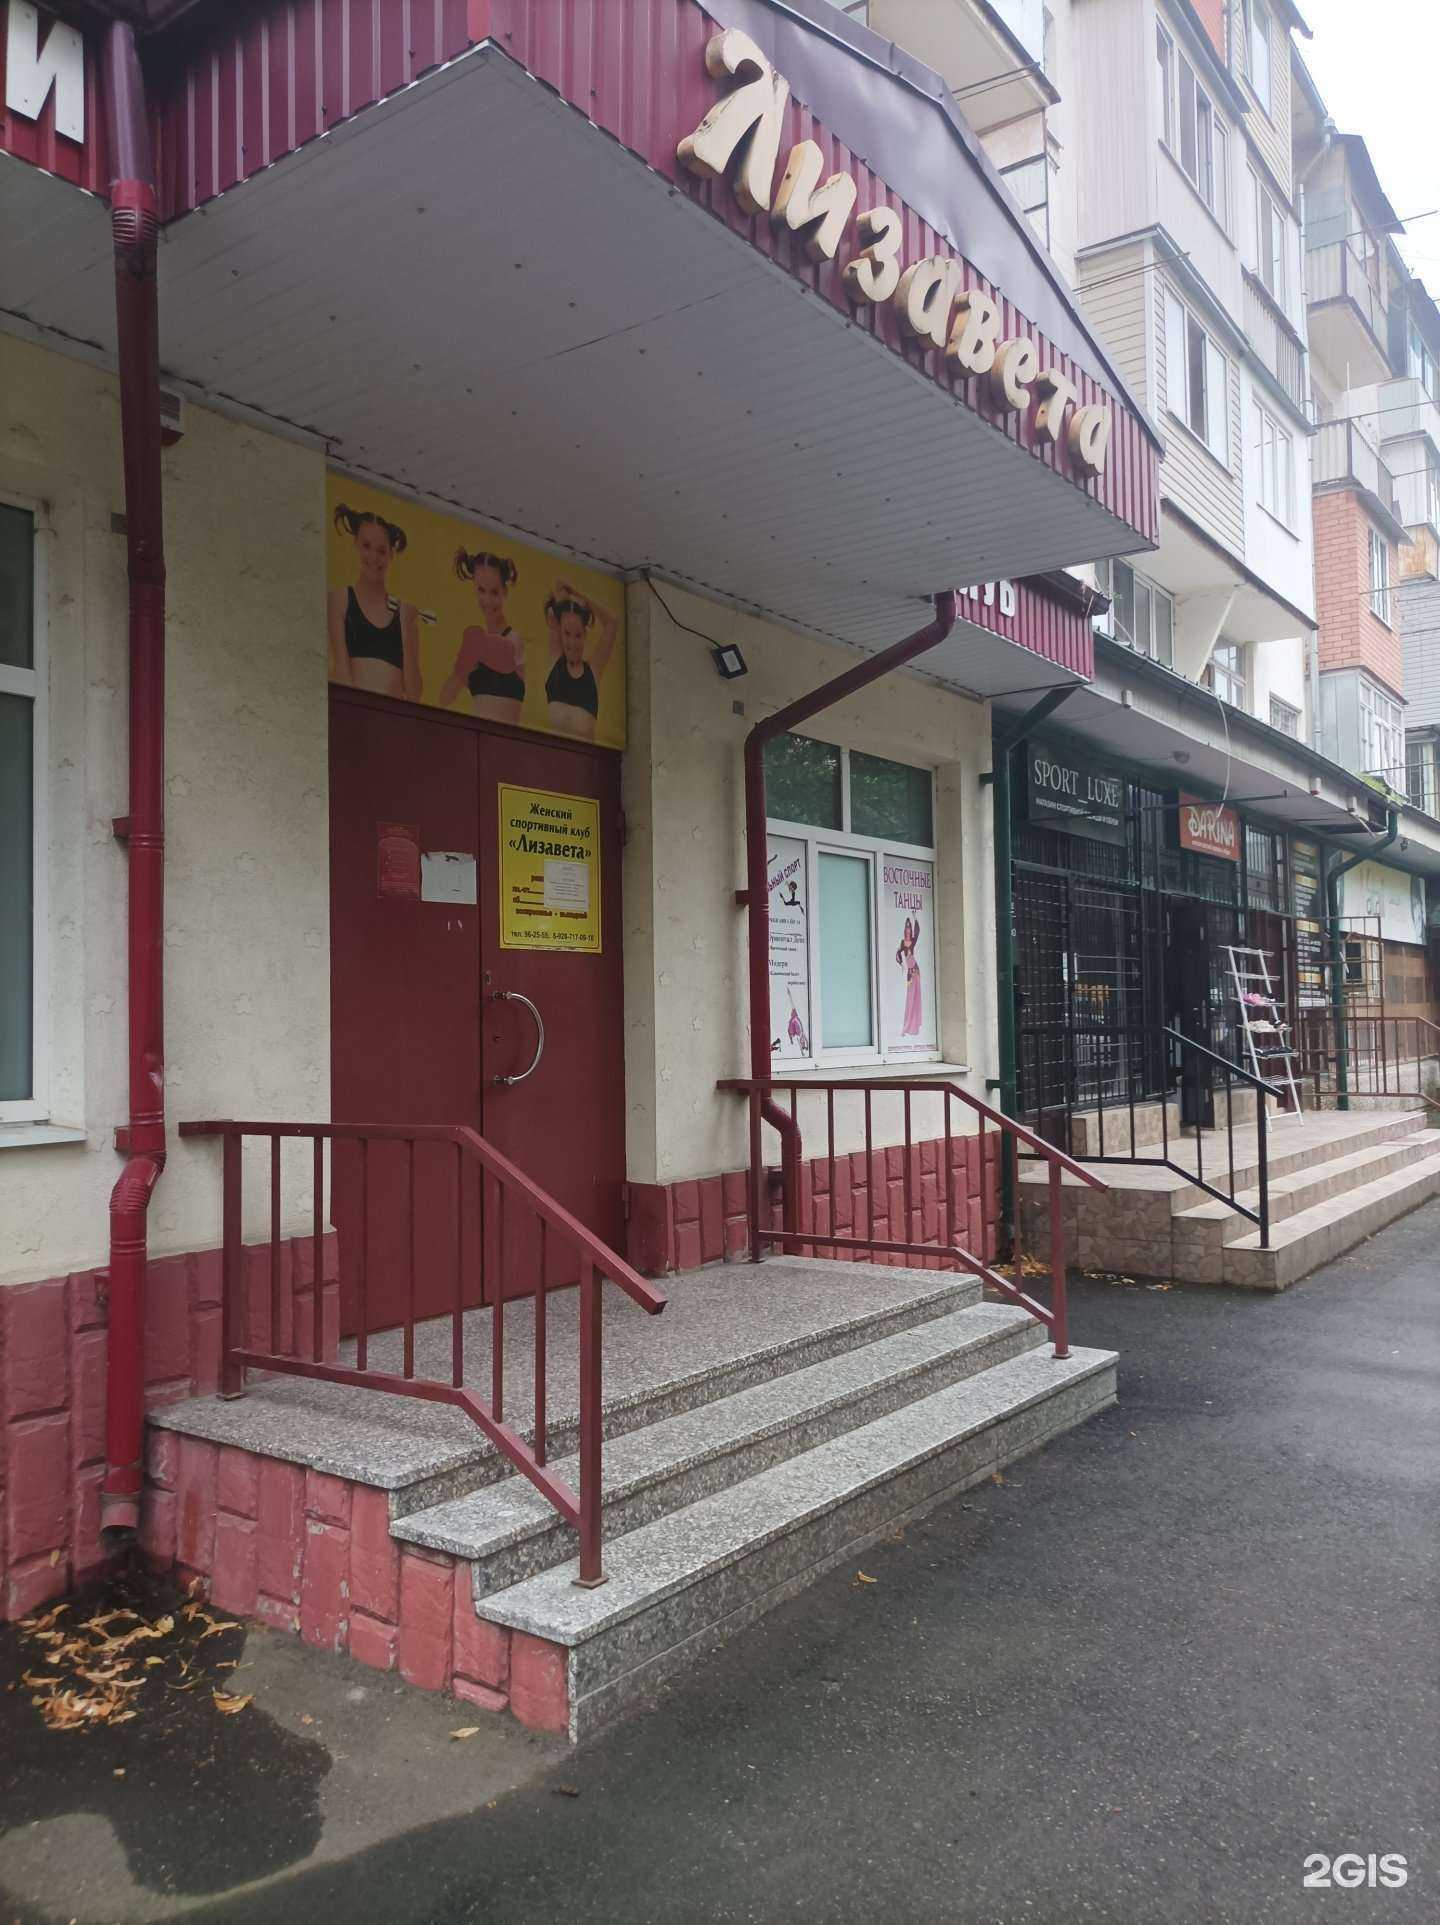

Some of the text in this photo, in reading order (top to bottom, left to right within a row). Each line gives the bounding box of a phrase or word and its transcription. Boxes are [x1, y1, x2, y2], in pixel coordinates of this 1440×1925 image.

[677, 27, 1109, 476] Лизавета
[529, 802, 573, 820] Женский
[510, 818, 591, 840] спортивный клуб
[508, 833, 592, 860] «Лизавета»
[768, 858, 801, 892] ЬНЫЙ СПОРТ
[883, 866, 931, 889] ВОСТОЧНЫЕ
[893, 891, 922, 912] ТАНЦЫ
